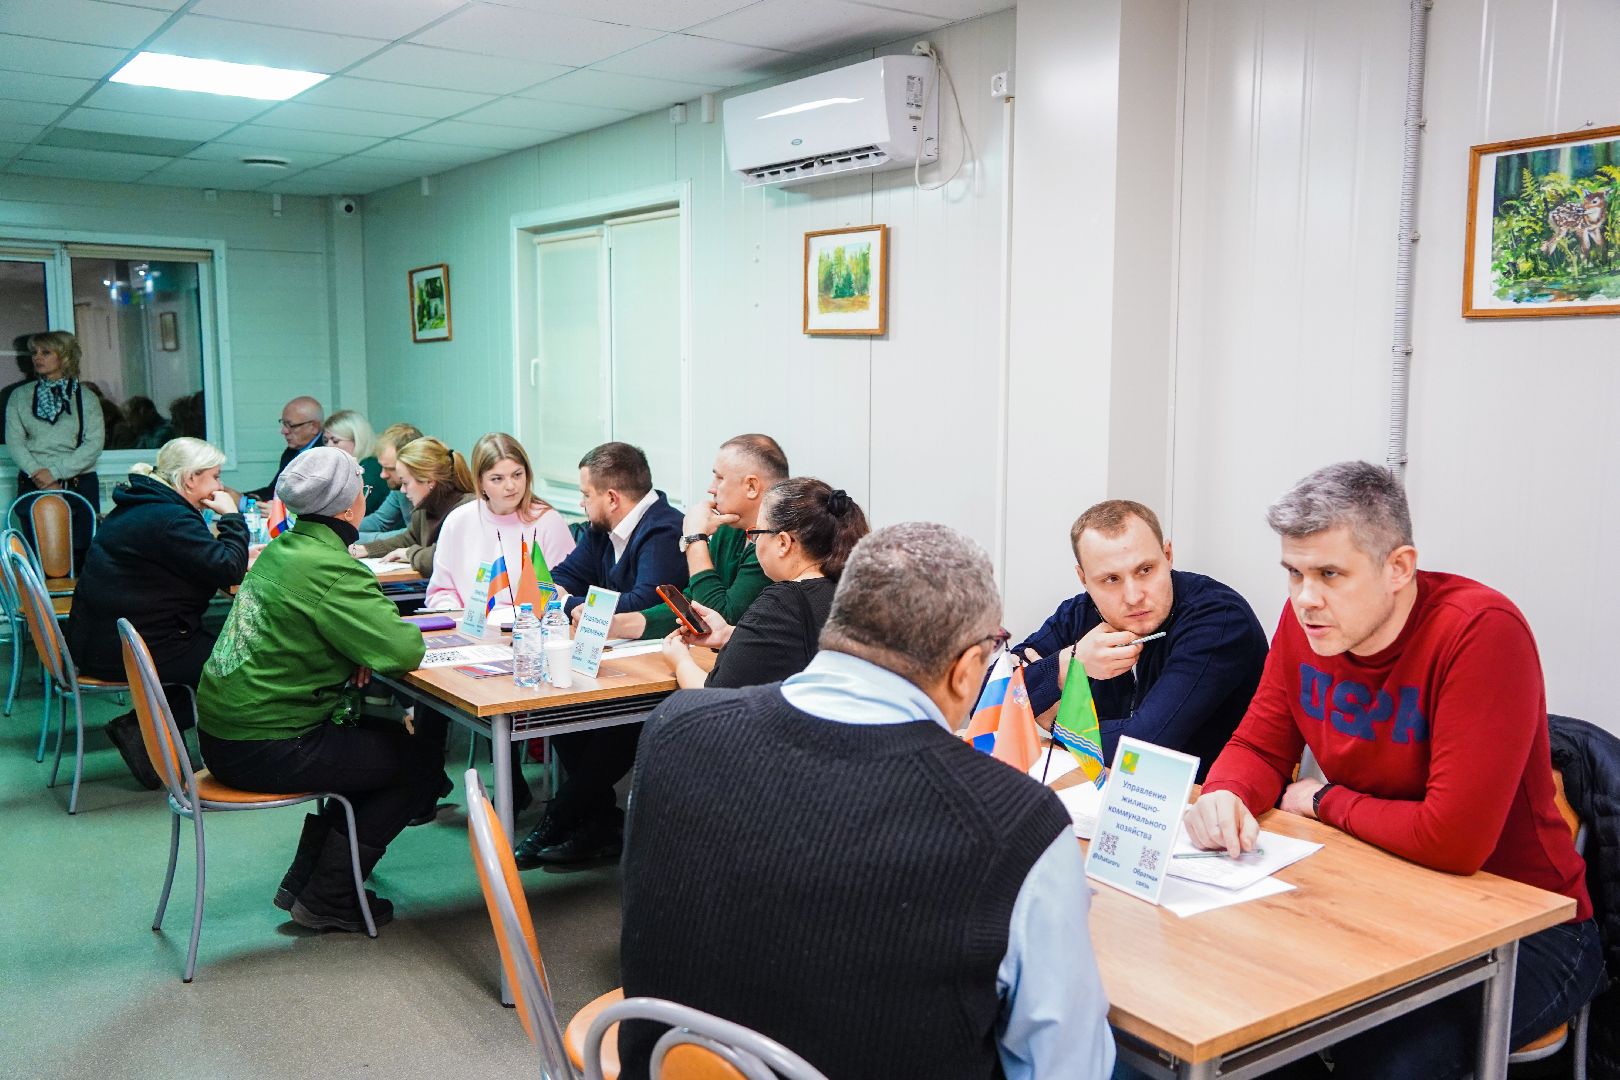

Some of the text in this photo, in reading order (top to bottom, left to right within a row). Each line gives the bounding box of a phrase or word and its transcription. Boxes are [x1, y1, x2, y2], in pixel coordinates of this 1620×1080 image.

[1299, 662, 1430, 744] USPA
[1122, 780, 1168, 802] Управление
[1121, 795, 1161, 813] жилищно-
[1107, 805, 1167, 831] коммунального
[1115, 822, 1153, 841] хозяйства
